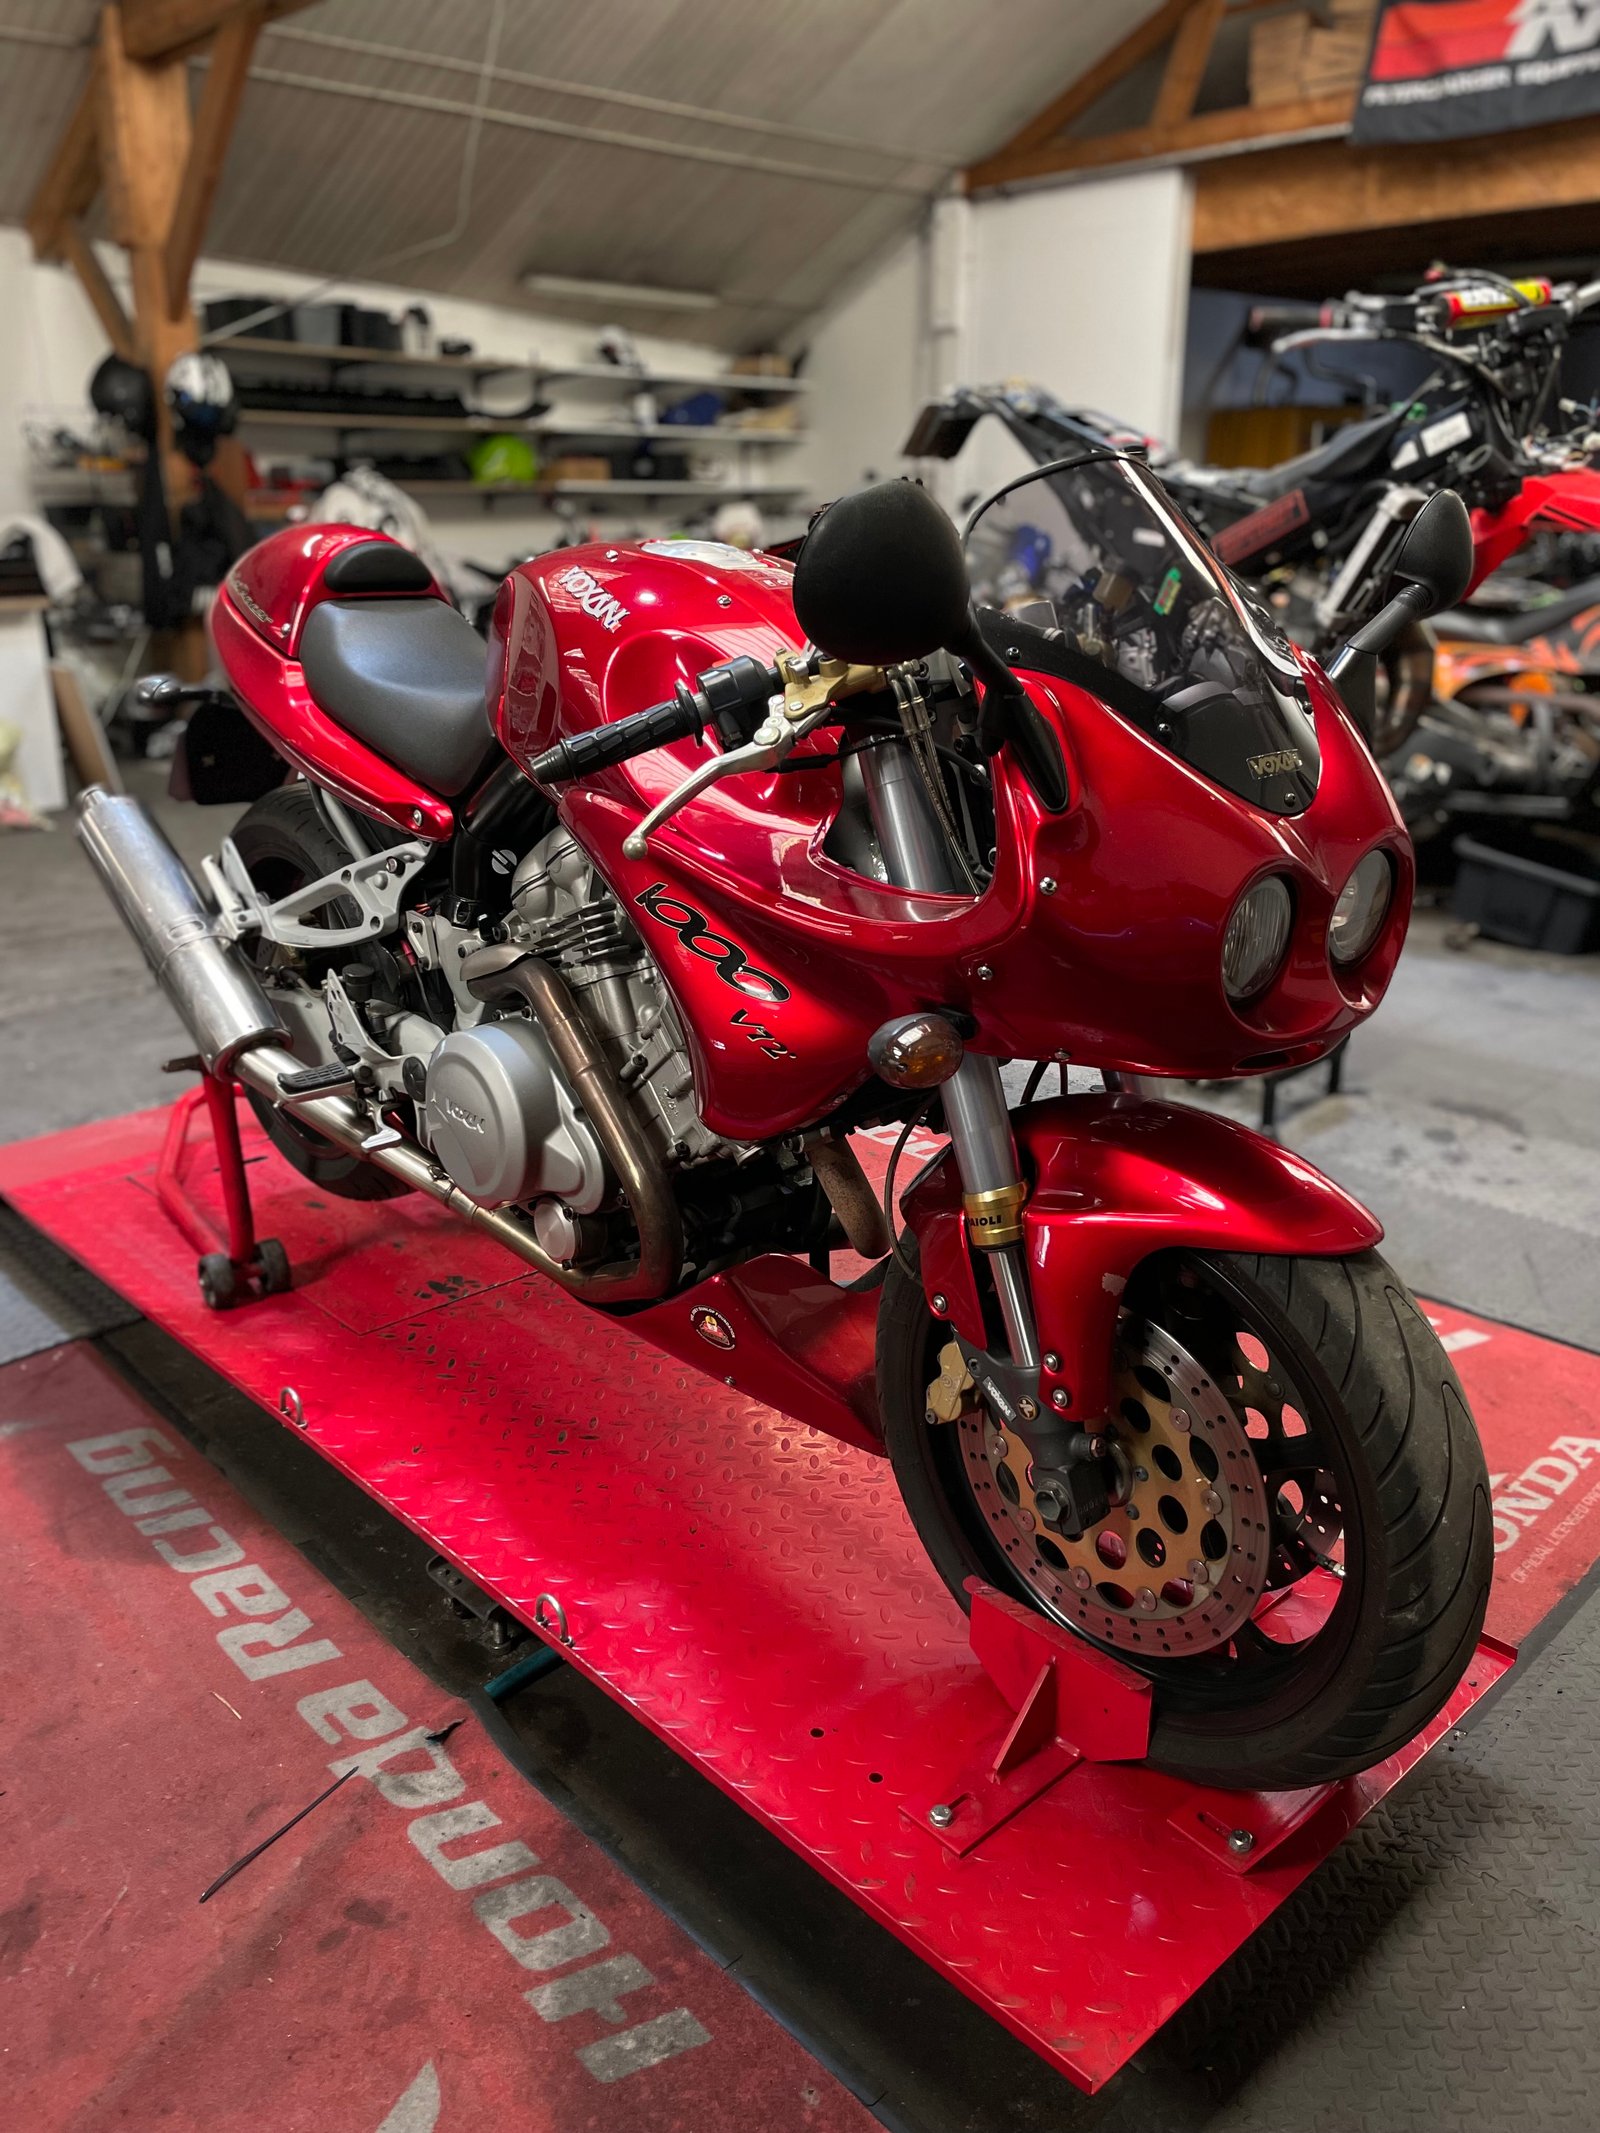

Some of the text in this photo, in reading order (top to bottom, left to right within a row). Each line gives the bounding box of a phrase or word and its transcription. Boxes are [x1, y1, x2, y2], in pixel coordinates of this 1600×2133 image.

[559, 565, 630, 631] VOXAN
[634, 881, 791, 1003] 1000
[986, 1381, 1012, 1417] VOXAN
[1493, 1435, 1600, 1553] ONDA
[1510, 1539, 1554, 1584] OFFICIAL
[1549, 1503, 1590, 1546] LICENSED
[64, 1427, 713, 2084] Honda Racing
